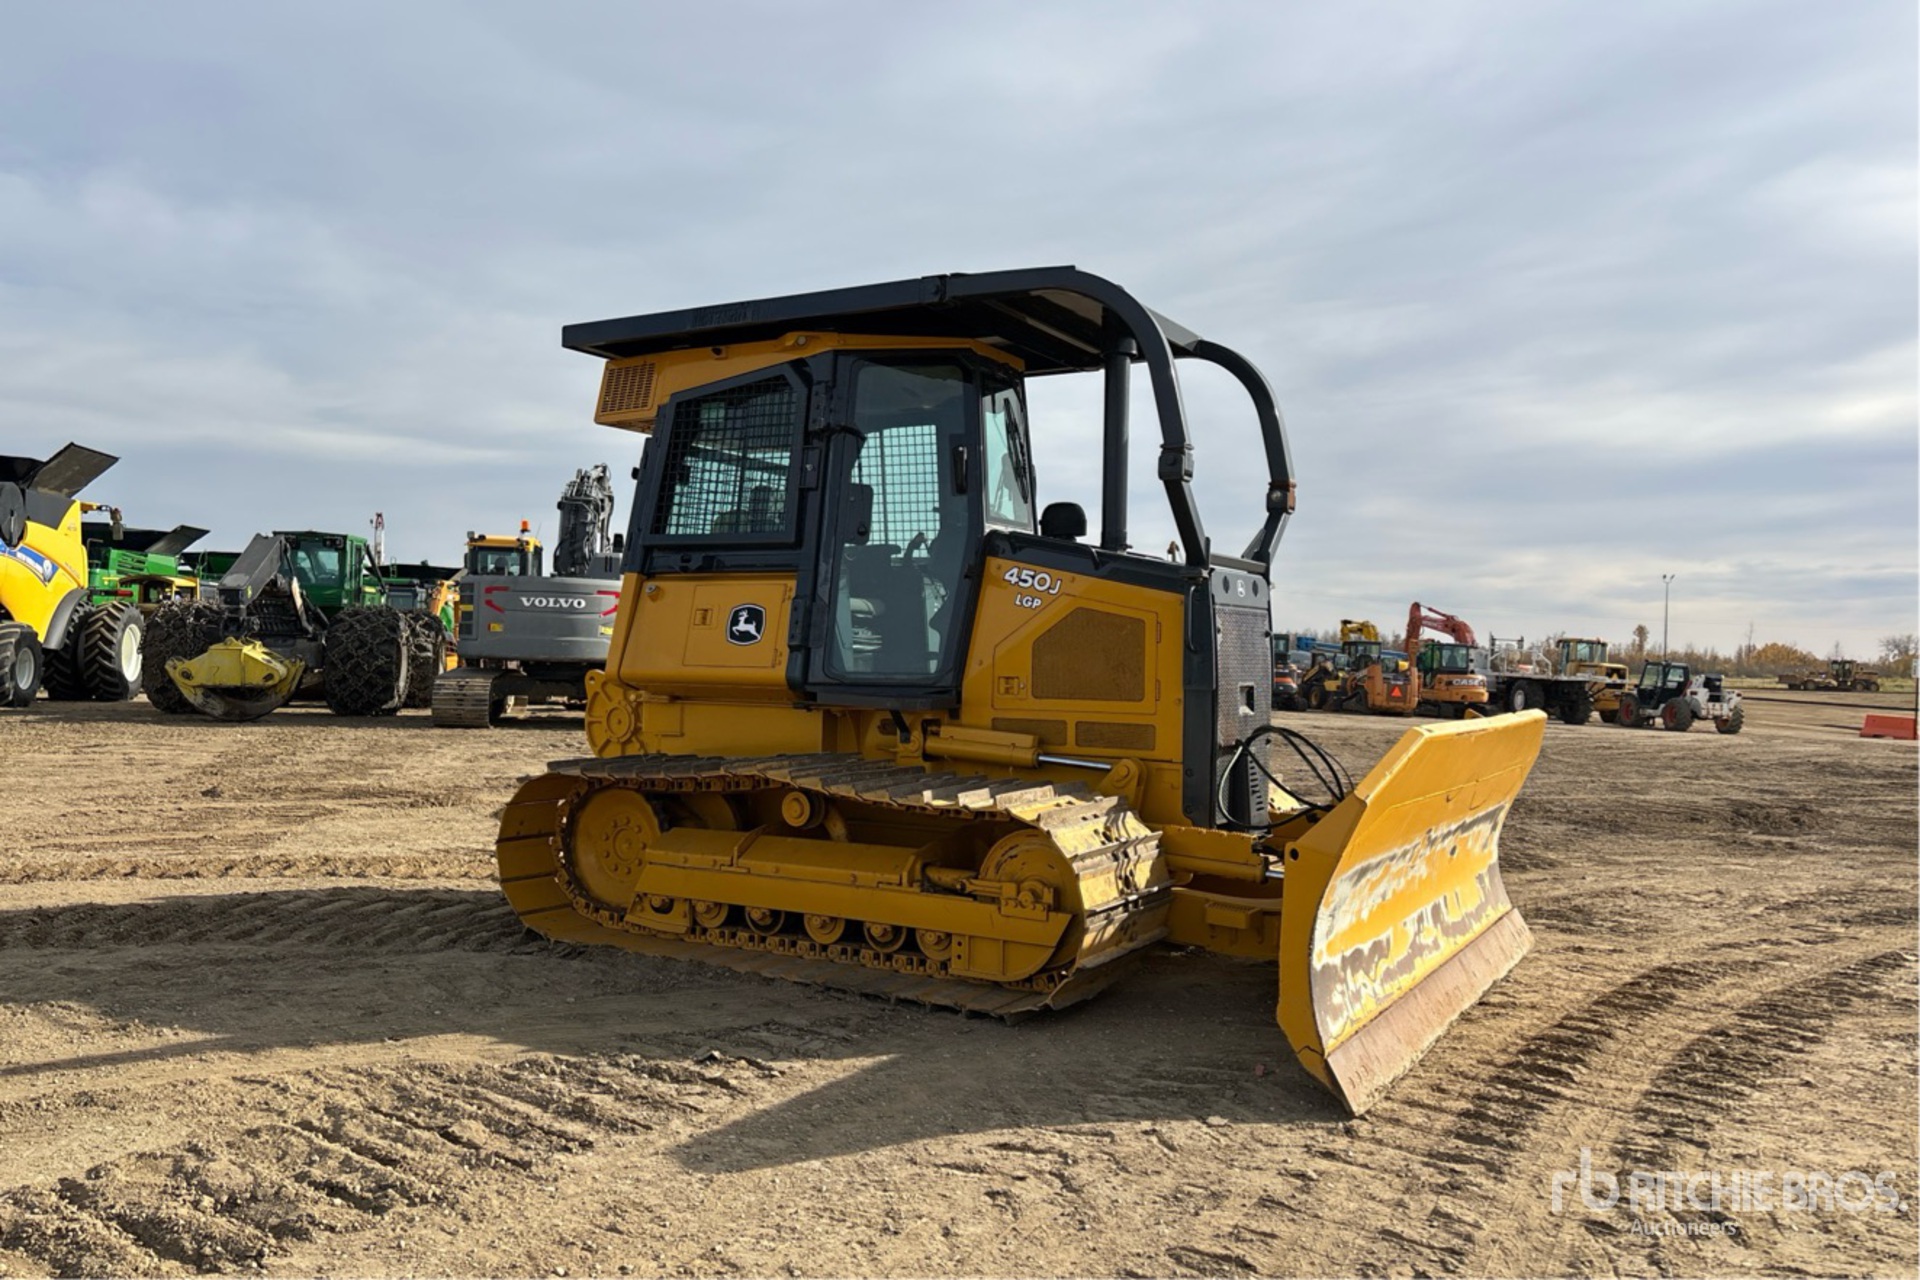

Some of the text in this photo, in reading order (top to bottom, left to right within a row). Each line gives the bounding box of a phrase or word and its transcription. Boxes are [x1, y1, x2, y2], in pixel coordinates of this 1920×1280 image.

[1004, 567, 1061, 594] 450J
[520, 597, 586, 609] VOLVO
[1015, 594, 1042, 608] LGP
